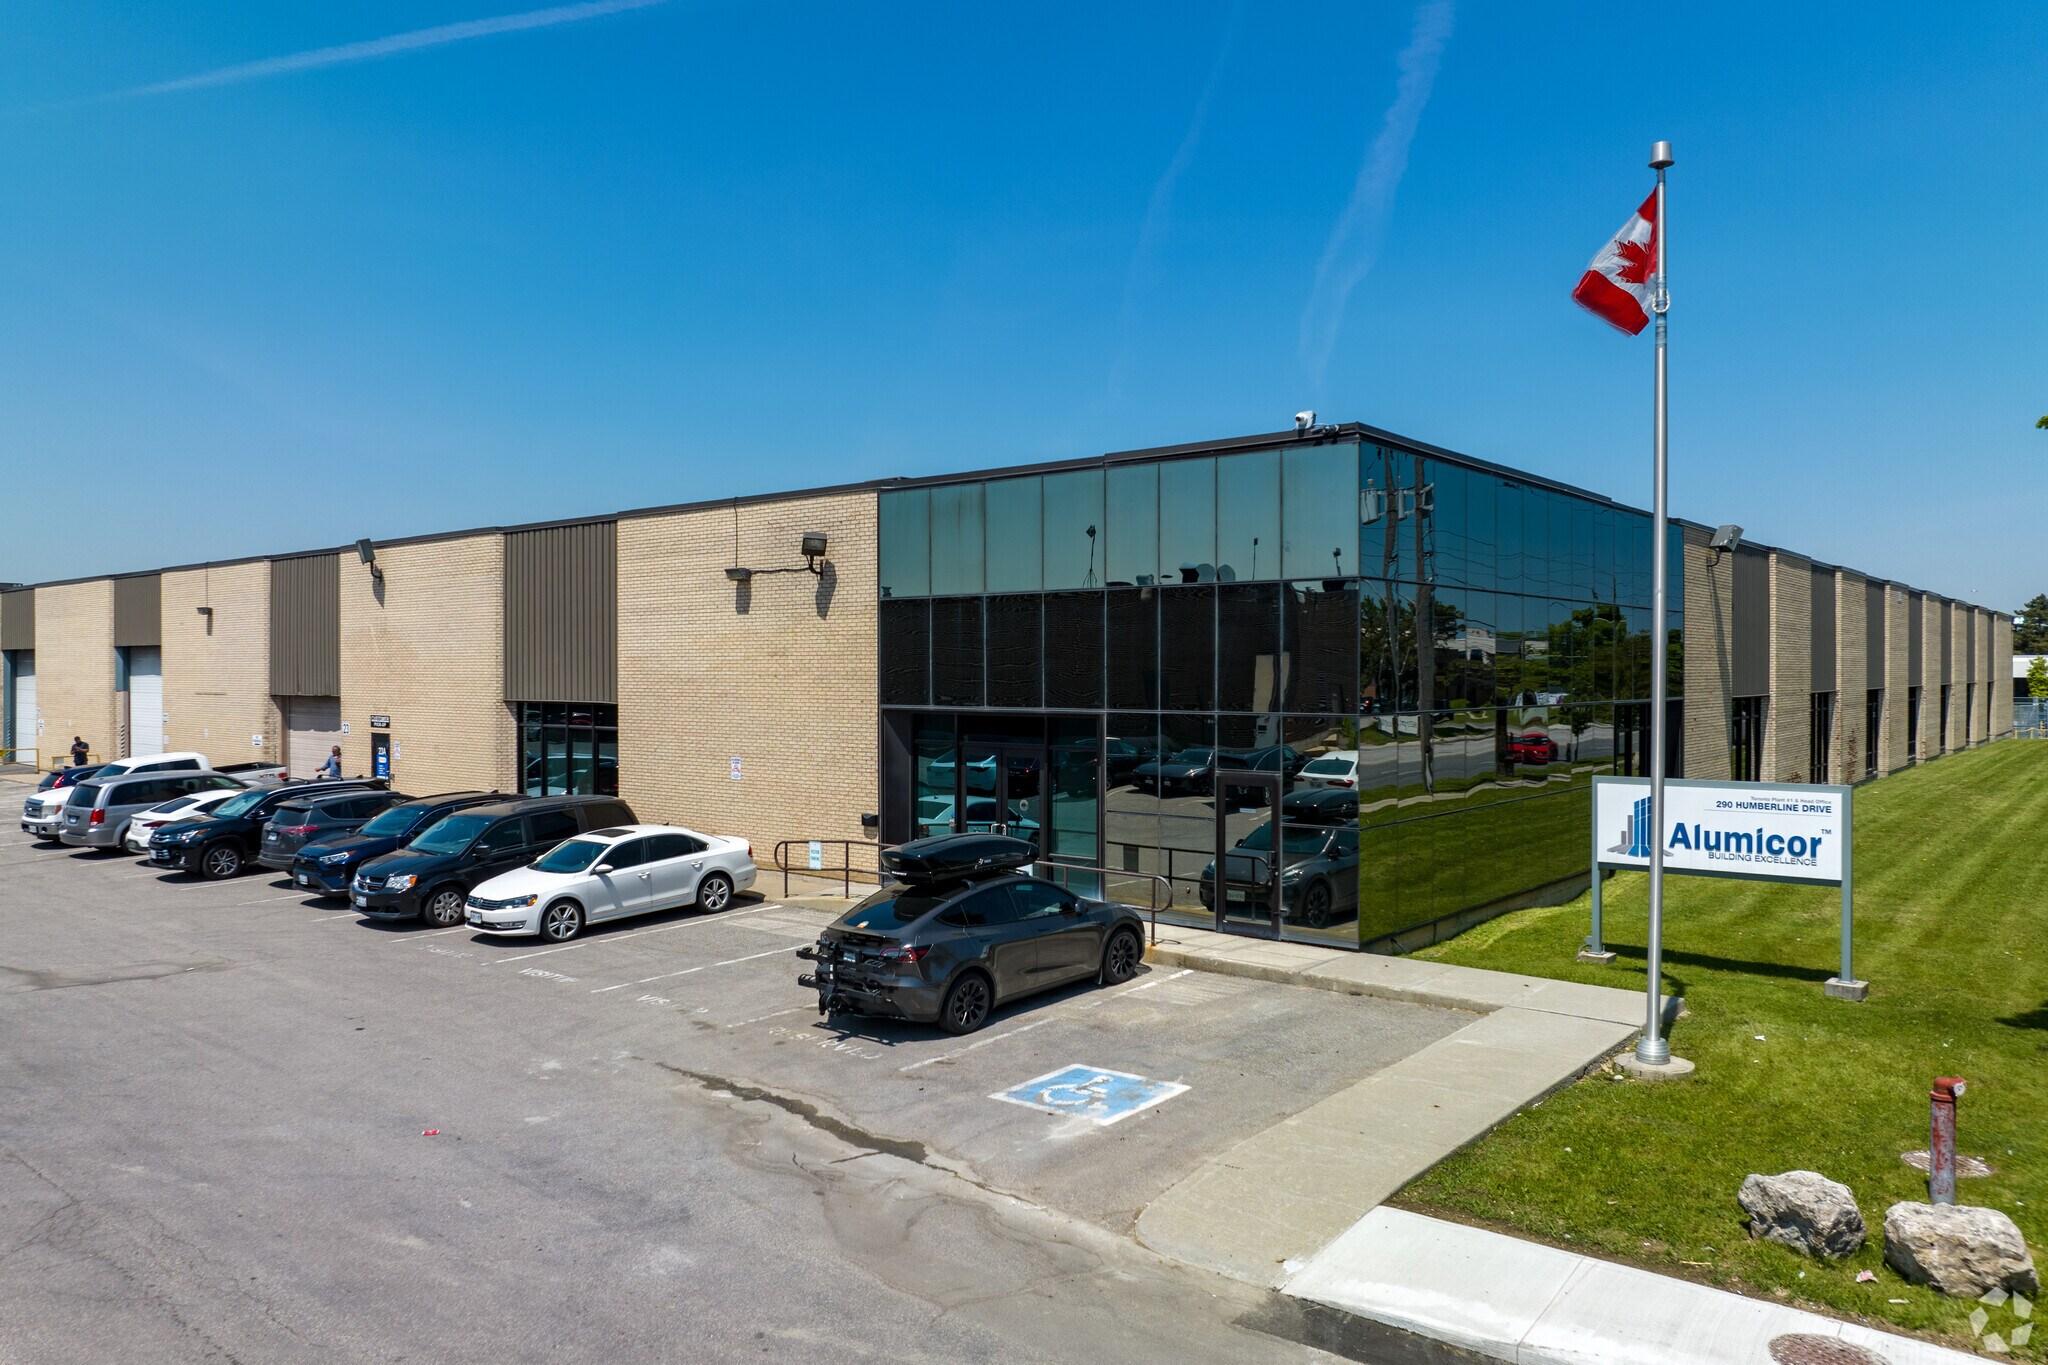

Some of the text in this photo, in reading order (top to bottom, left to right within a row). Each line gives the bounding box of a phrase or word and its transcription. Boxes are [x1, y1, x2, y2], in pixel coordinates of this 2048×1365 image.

[1716, 801, 1832, 814] 290 HUMBERLINE DRIVE
[1668, 822, 1822, 859] Alumicor
[1708, 852, 1817, 867] BUILDING EXCELLENCE
